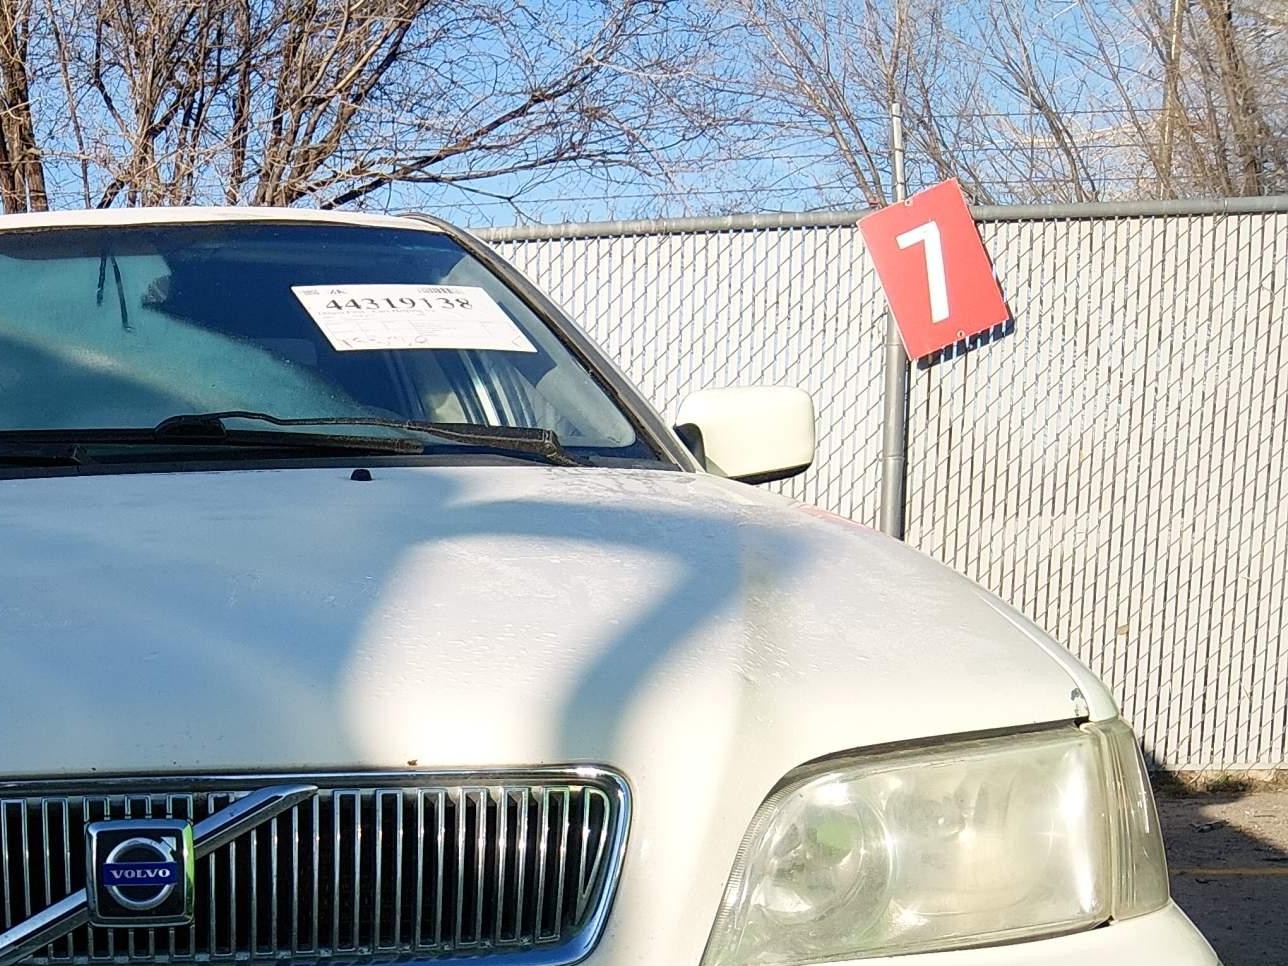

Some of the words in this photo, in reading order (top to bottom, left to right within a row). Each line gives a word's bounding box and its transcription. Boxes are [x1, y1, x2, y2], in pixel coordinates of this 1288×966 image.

[896, 220, 950, 324] 7
[326, 297, 473, 311] 44319138
[110, 868, 171, 879] VOLVO
